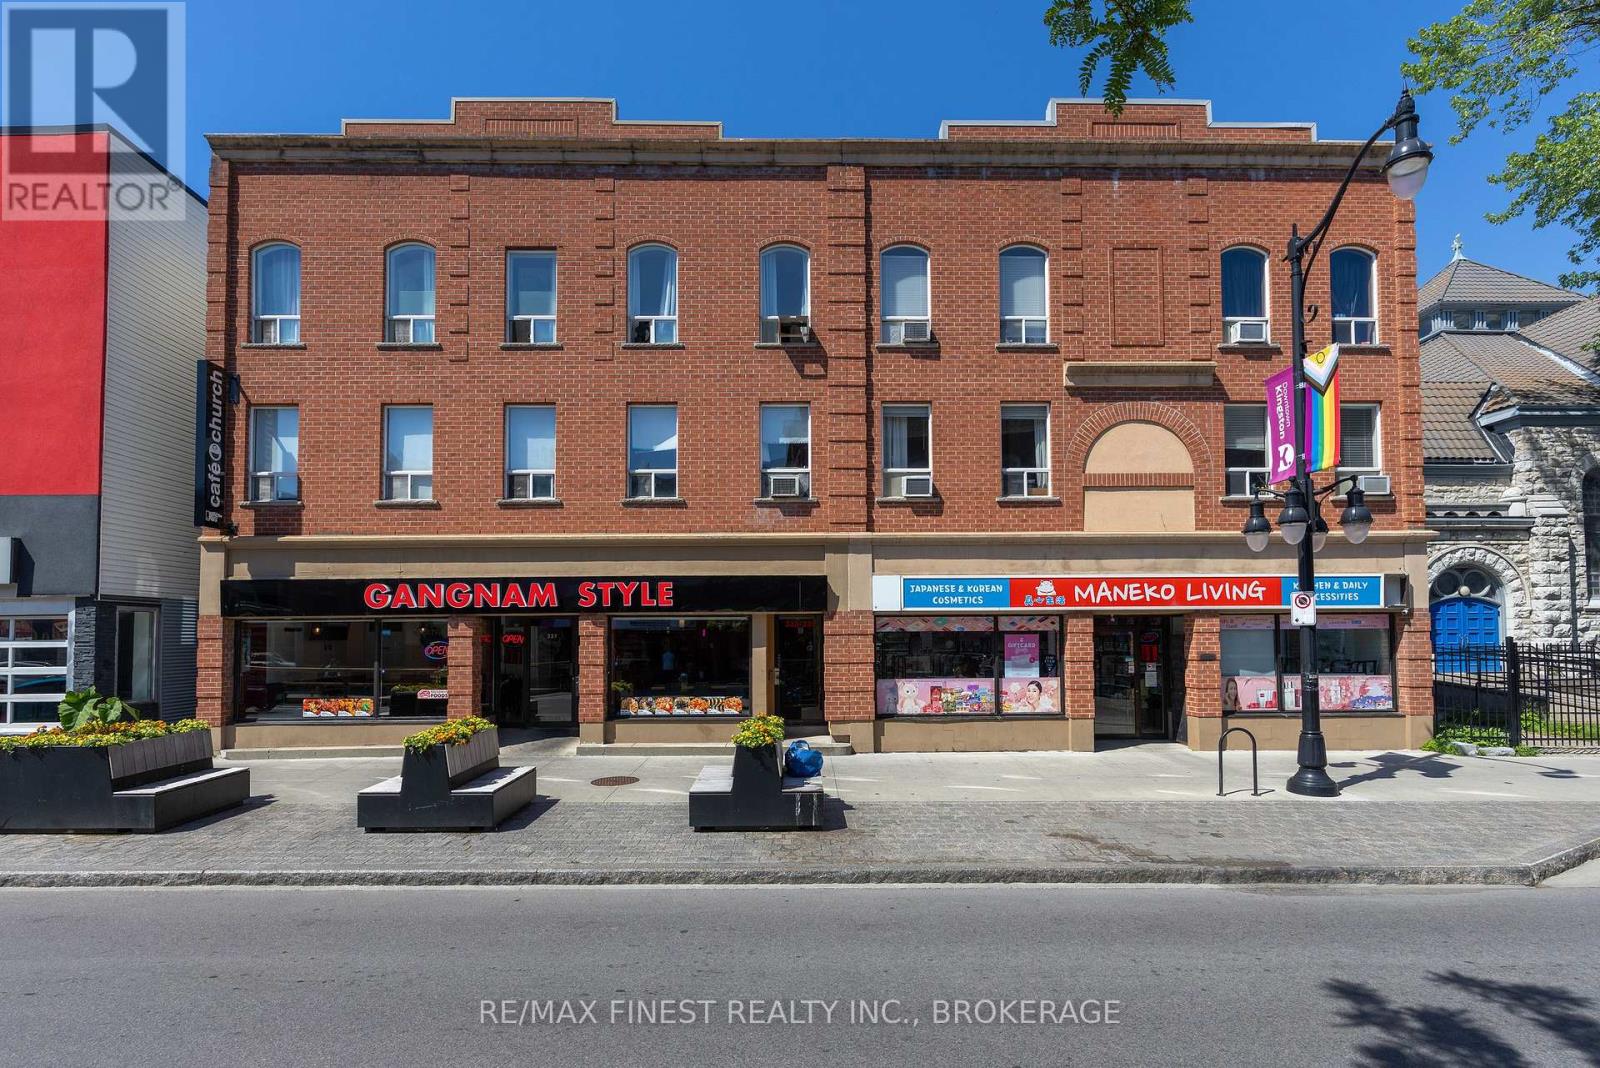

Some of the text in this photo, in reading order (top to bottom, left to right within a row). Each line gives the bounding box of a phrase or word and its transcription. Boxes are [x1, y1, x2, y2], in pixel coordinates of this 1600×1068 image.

[208, 369, 224, 443] church
[1274, 384, 1285, 440] Kingston
[1282, 381, 1291, 427] Downtown
[910, 584, 1003, 593] JAPANESE & KOREAN
[1074, 580, 1266, 603] MANEKO LIVING
[1292, 581, 1369, 590] KHEN & DAILY
[363, 581, 674, 609] GANGNAM STYLE
[932, 596, 984, 604] COSMETICS
[1314, 592, 1359, 601] CESSITIES
[502, 634, 524, 644] OPEN
